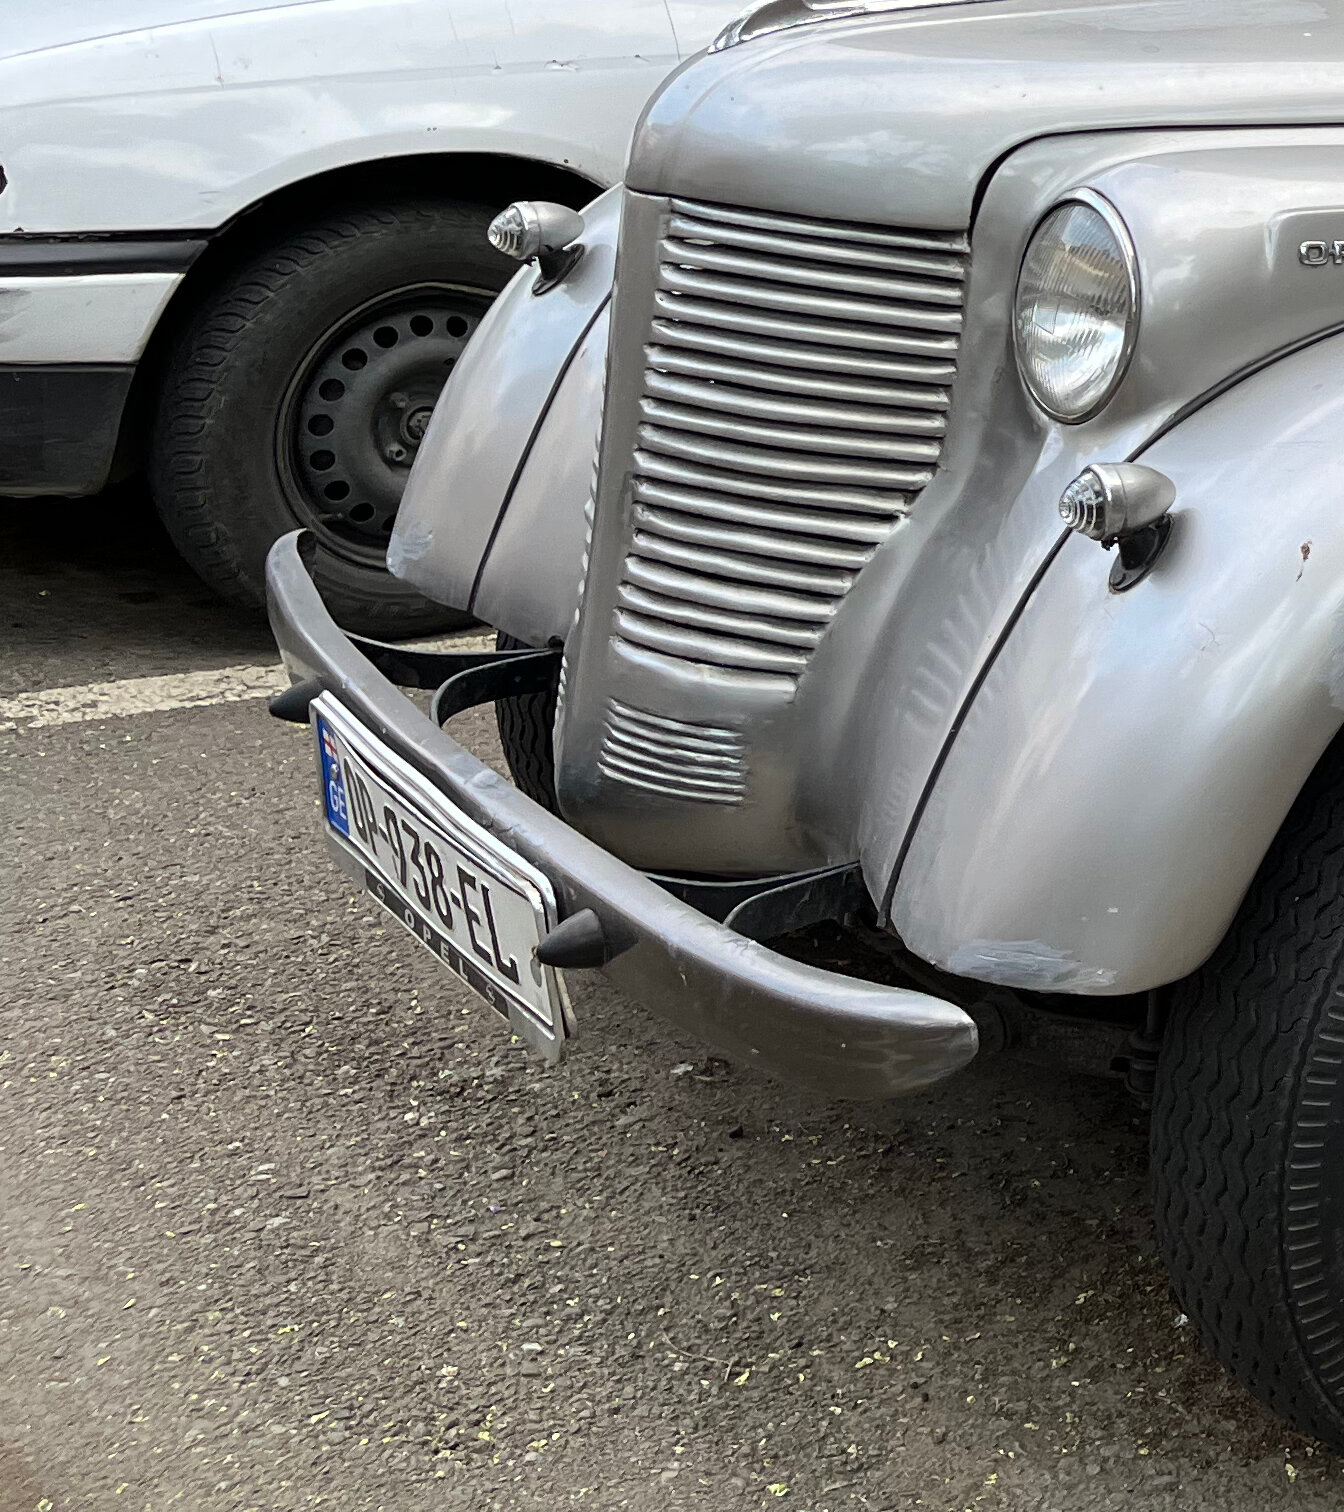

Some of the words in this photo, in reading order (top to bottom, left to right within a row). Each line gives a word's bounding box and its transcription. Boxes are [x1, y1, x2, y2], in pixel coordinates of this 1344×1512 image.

[328, 779, 348, 820] GE
[343, 755, 520, 986] OP-938-EL
[404, 909, 471, 981] OPEL
